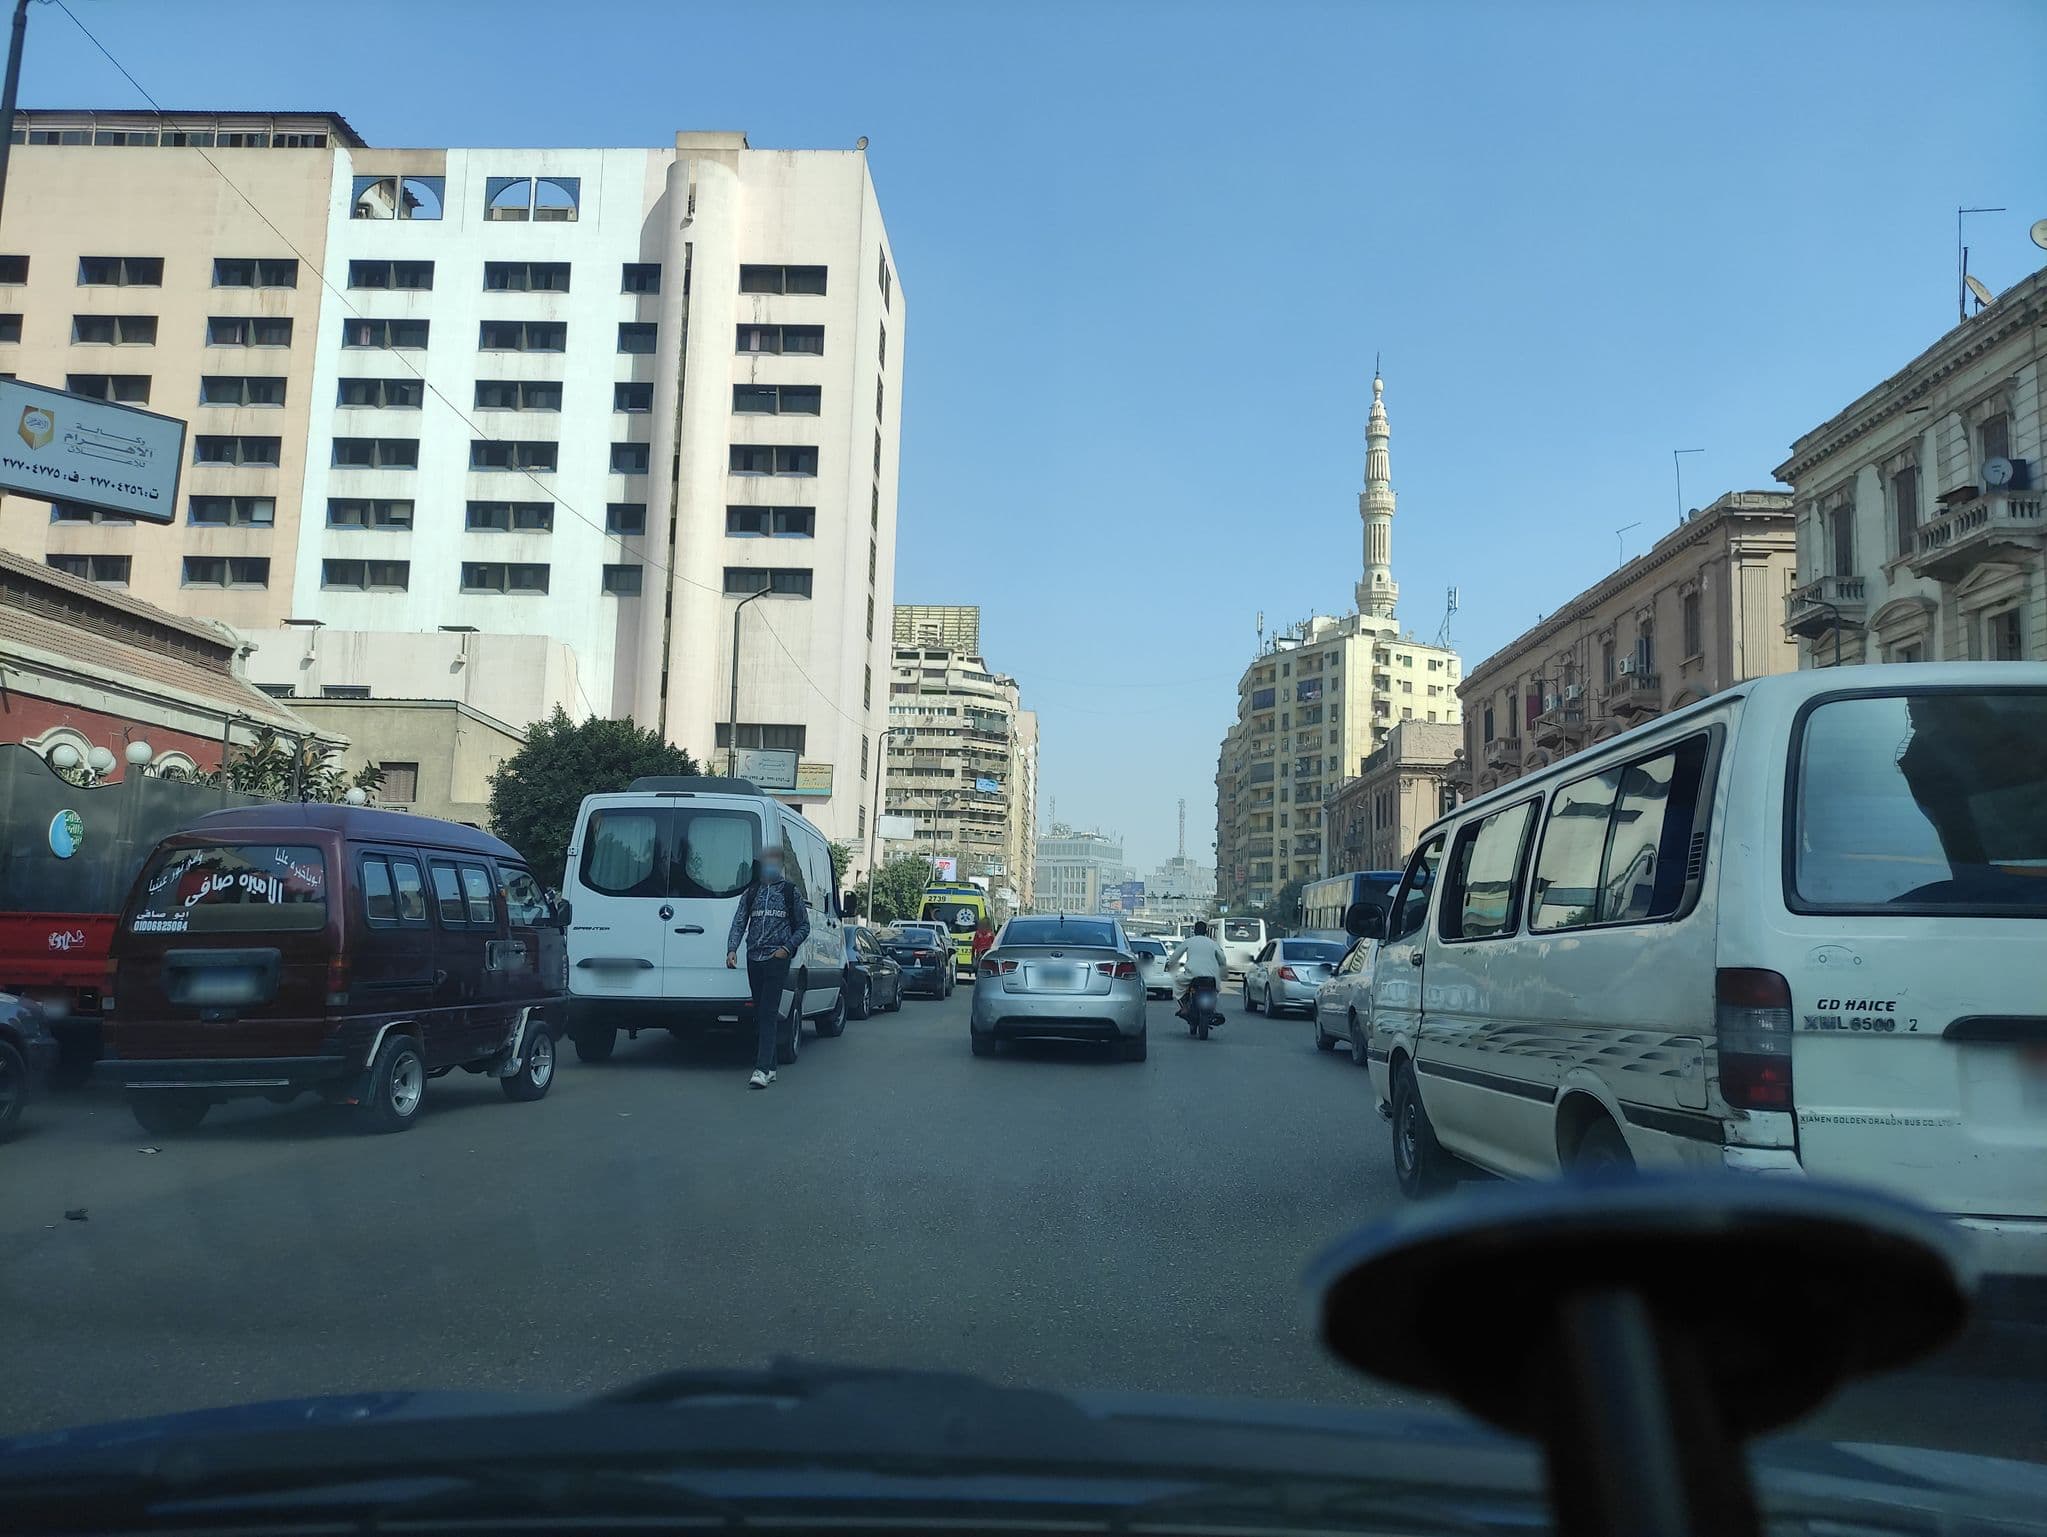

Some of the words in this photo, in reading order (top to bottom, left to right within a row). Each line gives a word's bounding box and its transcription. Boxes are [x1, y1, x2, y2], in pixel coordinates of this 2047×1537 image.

[134, 920, 188, 931] 01006825084
[1817, 999, 1840, 1010] GD
[1845, 999, 1896, 1011] HAICE
[1801, 1115, 1832, 1124] XIAMEN
[1833, 1116, 1867, 1125] GOLDEN
